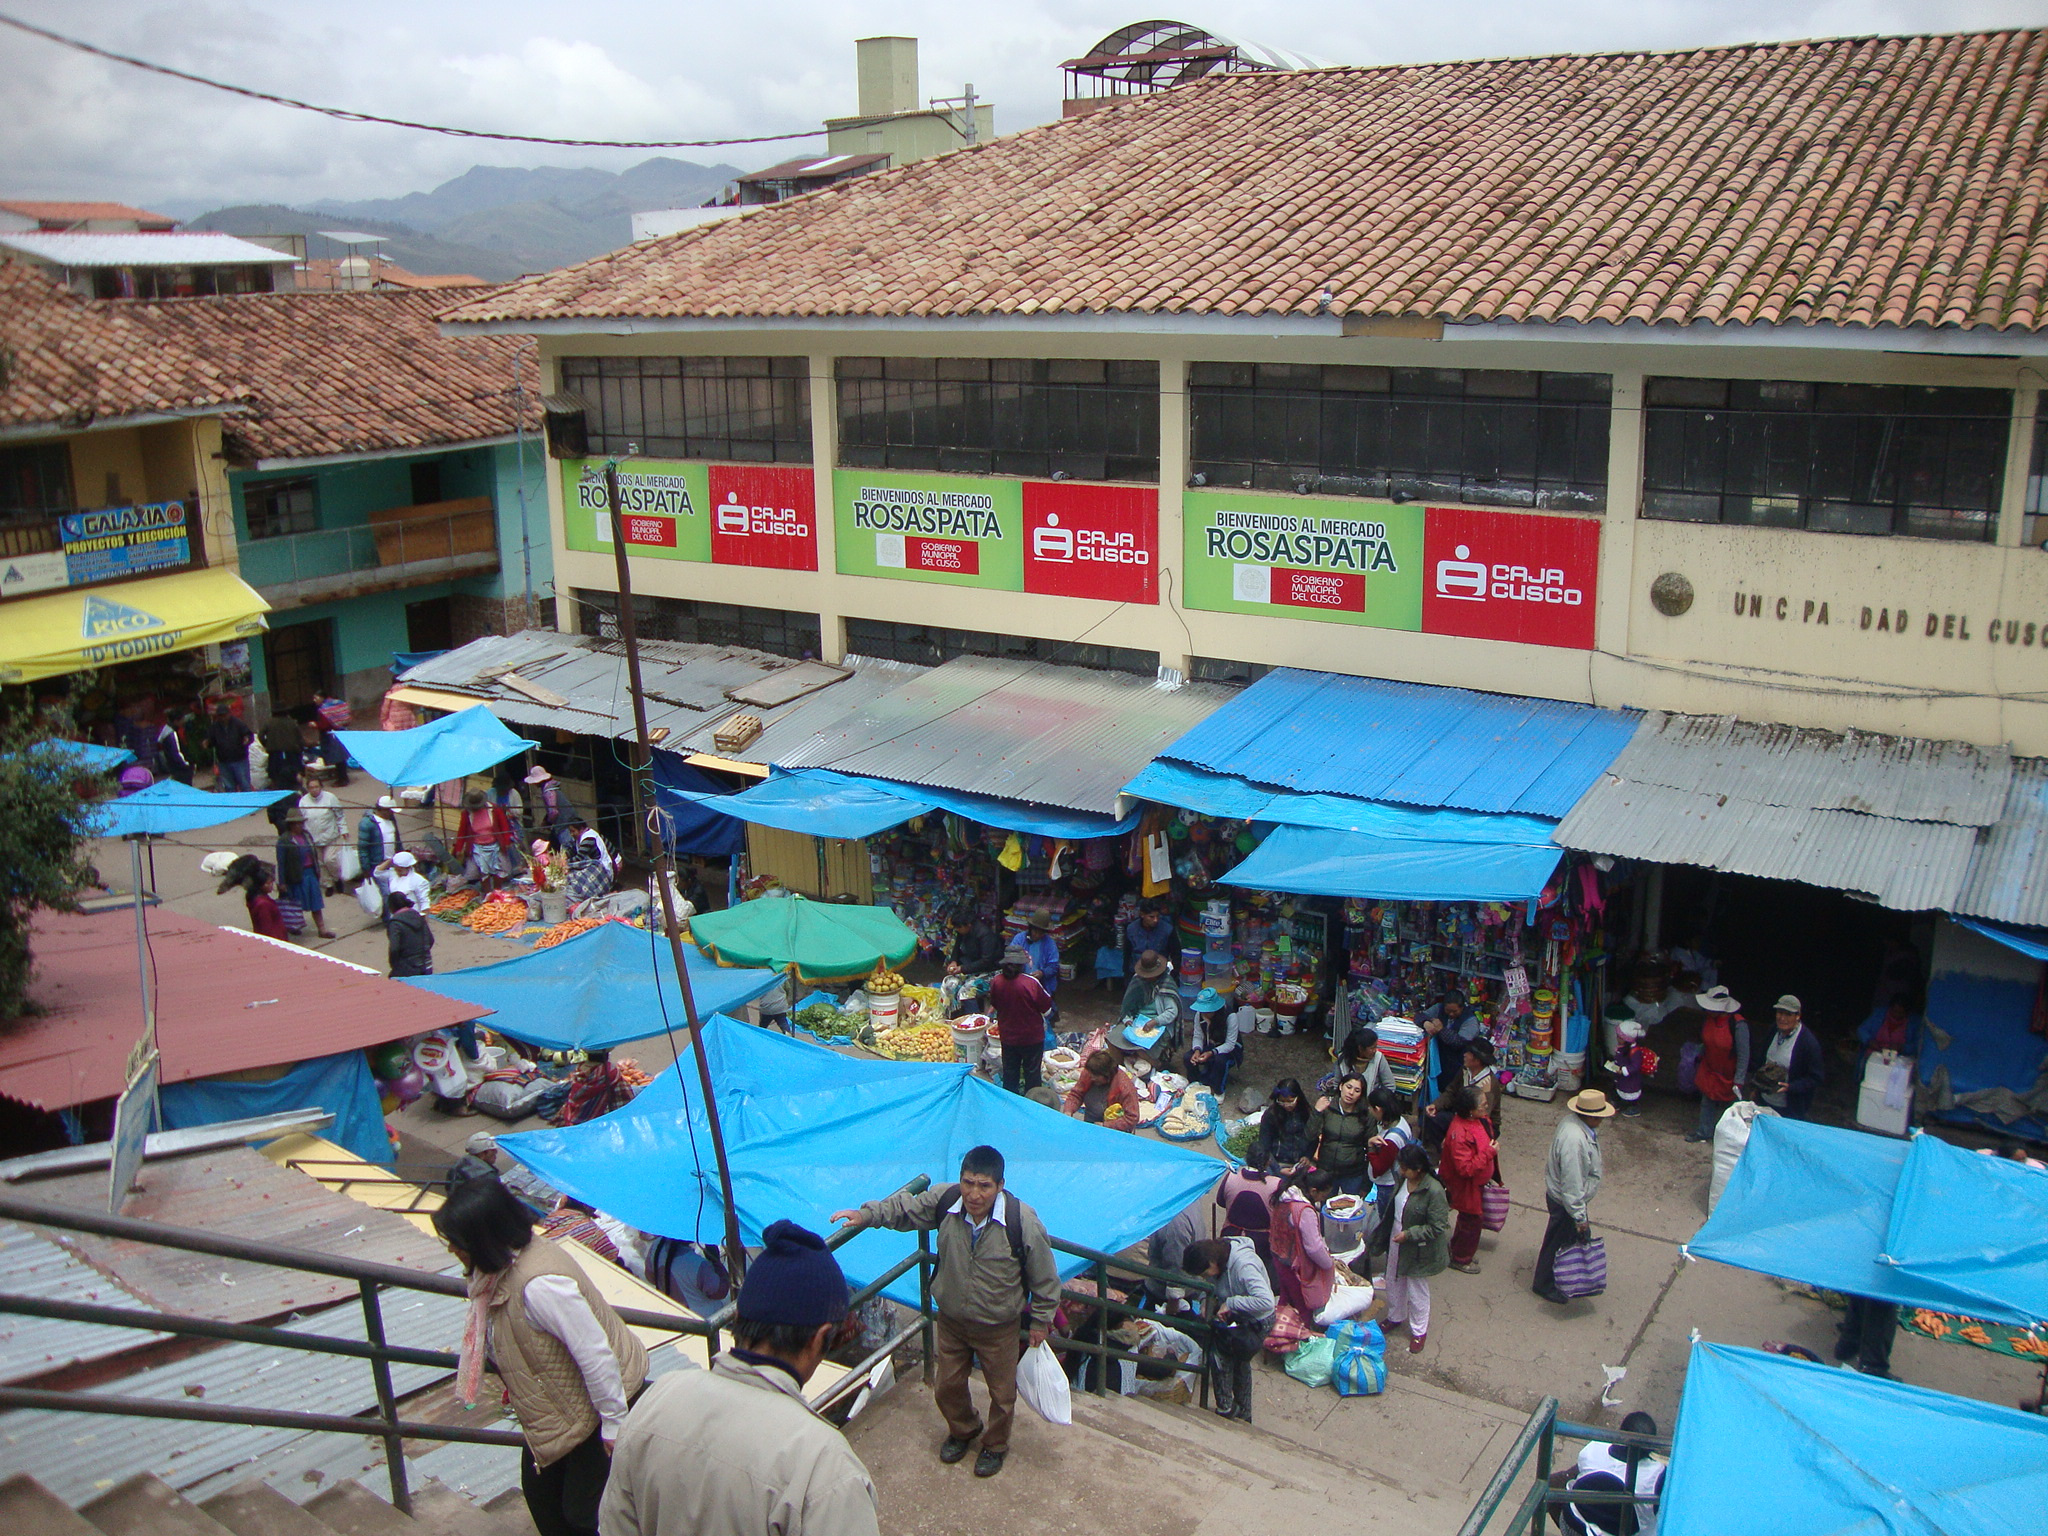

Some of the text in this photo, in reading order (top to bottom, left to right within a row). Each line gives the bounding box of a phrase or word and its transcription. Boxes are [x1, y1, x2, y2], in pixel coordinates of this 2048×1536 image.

[635, 475, 645, 487] AL
[646, 476, 686, 489] MERCADO
[579, 485, 694, 515] ROASPATA
[862, 488, 992, 509] BIENVENIDOS AL MERCADO
[83, 506, 167, 535] GALAXIA
[752, 506, 795, 521] CAJA
[854, 502, 1002, 538] ROSASPATA
[631, 519, 663, 529] GOBIERNO
[752, 521, 808, 537] CUSCO
[1217, 512, 1385, 539] BIENVENIDOS AL MERCADO
[65, 535, 125, 556] PROYECTOS
[128, 533, 136, 546] Y
[631, 533, 663, 543] DEL CUSCO
[921, 542, 962, 553] GOBIERNO
[1077, 530, 1134, 548] CAJA
[921, 550, 958, 560] MUNICIPAL
[1077, 545, 1149, 565] CUSCO
[1206, 528, 1397, 571] ROSASPATA
[921, 558, 961, 569] DEL CUSCO
[1291, 574, 1344, 587] GOBIERNO
[1491, 564, 1564, 586] CAJA
[1291, 583, 1339, 596] MUNICIPAL
[1291, 592, 1342, 605] DEL CUSCO
[1491, 583, 1582, 606] CUSCO
[93, 614, 150, 635] RICO
[1924, 612, 1970, 640] DEL
